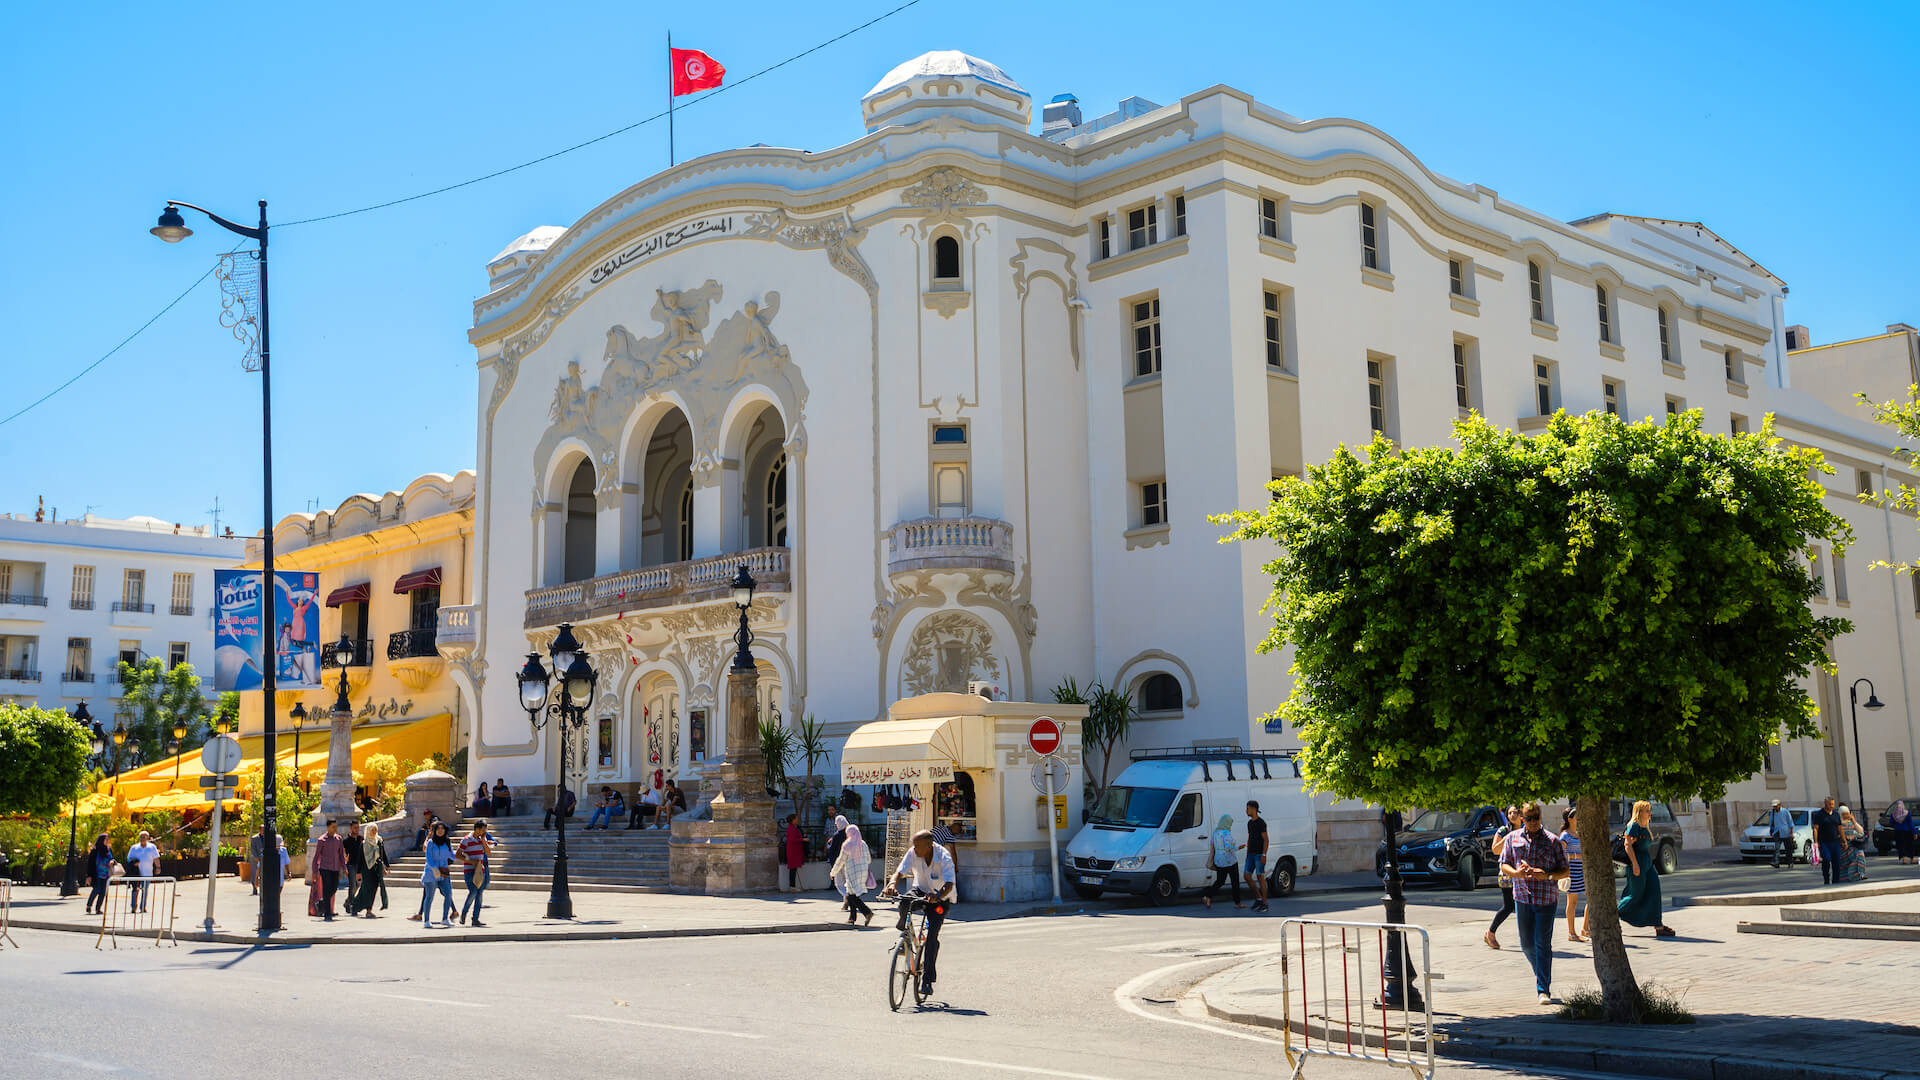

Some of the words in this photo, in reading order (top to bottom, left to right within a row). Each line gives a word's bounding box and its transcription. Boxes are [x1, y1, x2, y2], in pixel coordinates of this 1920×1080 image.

[590, 235, 663, 284] البلدي
[216, 588, 260, 606] lotus
[928, 766, 951, 779] TABAC
